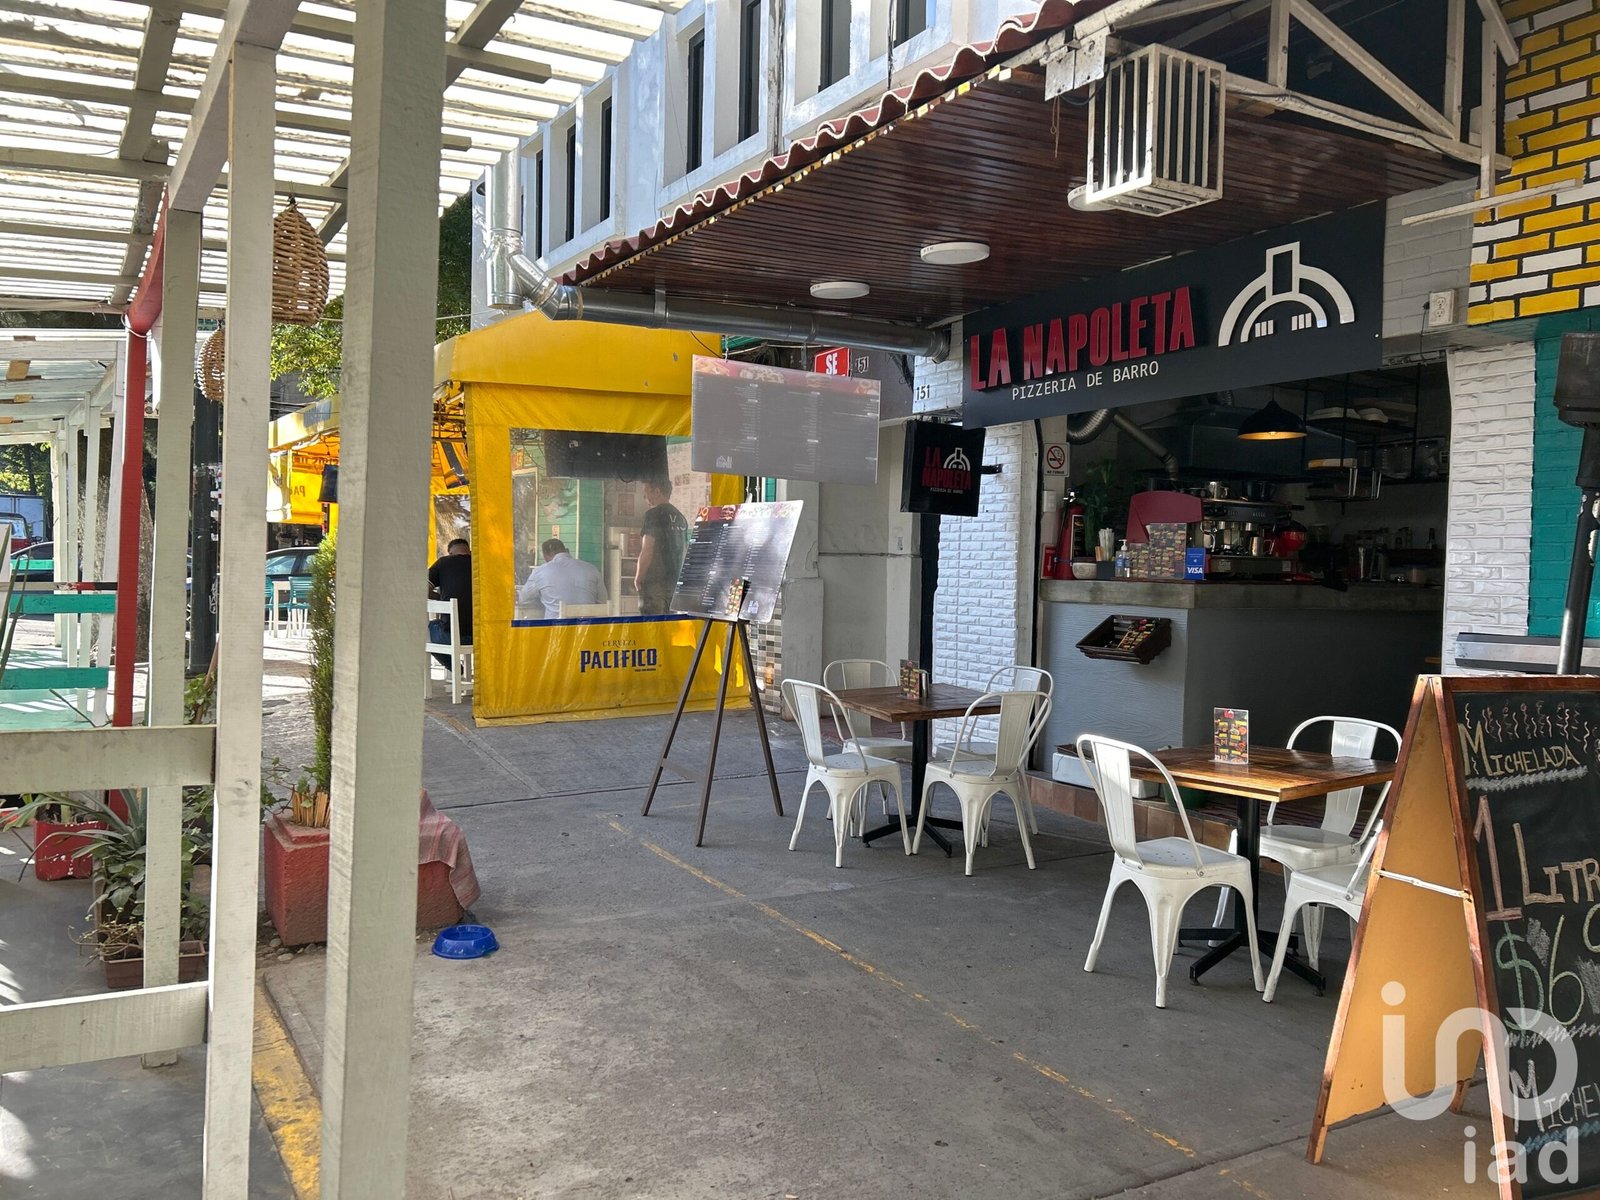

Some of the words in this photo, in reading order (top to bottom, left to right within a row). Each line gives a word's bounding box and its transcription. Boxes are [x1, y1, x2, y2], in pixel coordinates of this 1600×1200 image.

[970, 327, 1012, 392] LA
[1022, 286, 1196, 381] NAPOLETA
[825, 352, 838, 375] SE
[856, 356, 869, 373] 151
[1012, 377, 1077, 401] PIZZERIA
[1086, 371, 1103, 388] DE
[1113, 361, 1159, 382] BARRO
[916, 385, 930, 402] 151
[924, 447, 941, 467] LA
[921, 467, 972, 490] NAPOLETA
[602, 640, 636, 649] CERVEZA
[580, 649, 657, 672] PACIFICO
[1456, 720, 1580, 777] MICHELADA
[1472, 794, 1522, 921] 1
[1509, 1058, 1600, 1134] MICHE
